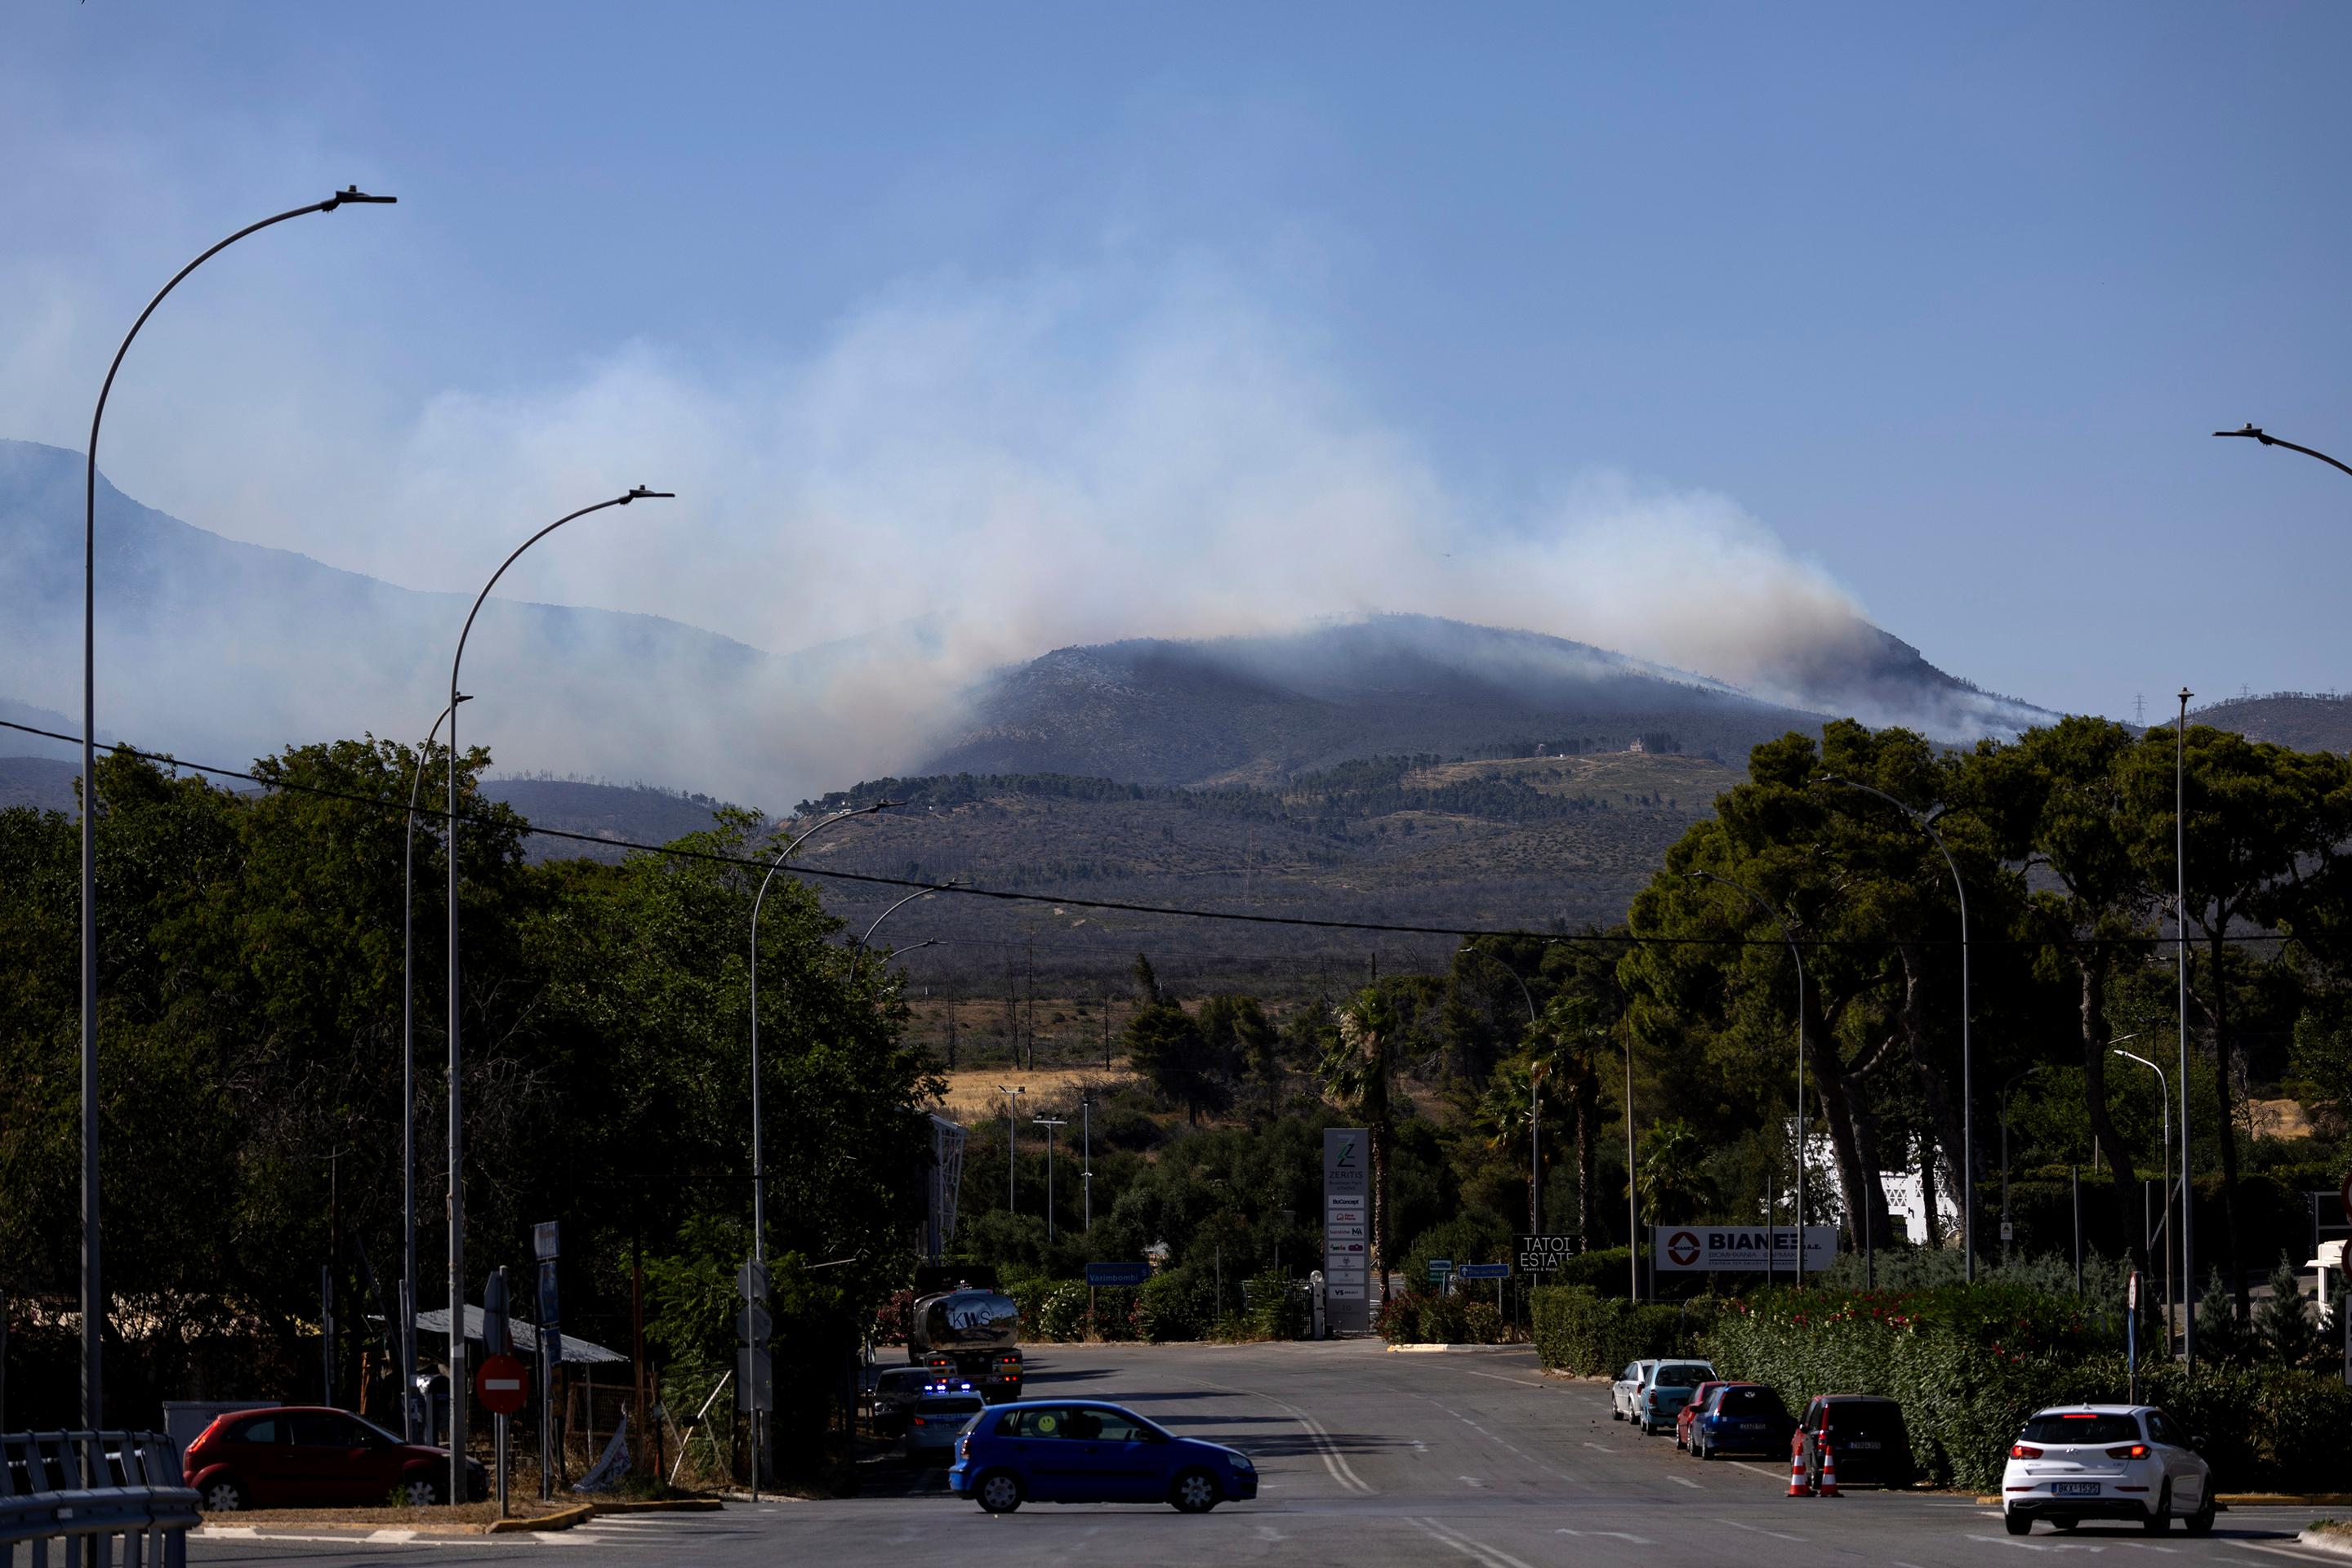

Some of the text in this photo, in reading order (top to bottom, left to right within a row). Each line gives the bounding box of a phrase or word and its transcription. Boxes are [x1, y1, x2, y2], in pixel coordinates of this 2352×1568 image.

[1329, 1170, 1363, 1178] ZERITIS
[1523, 1237, 1570, 1251] TATOI
[1089, 1273, 1138, 1281] Varimbombi
